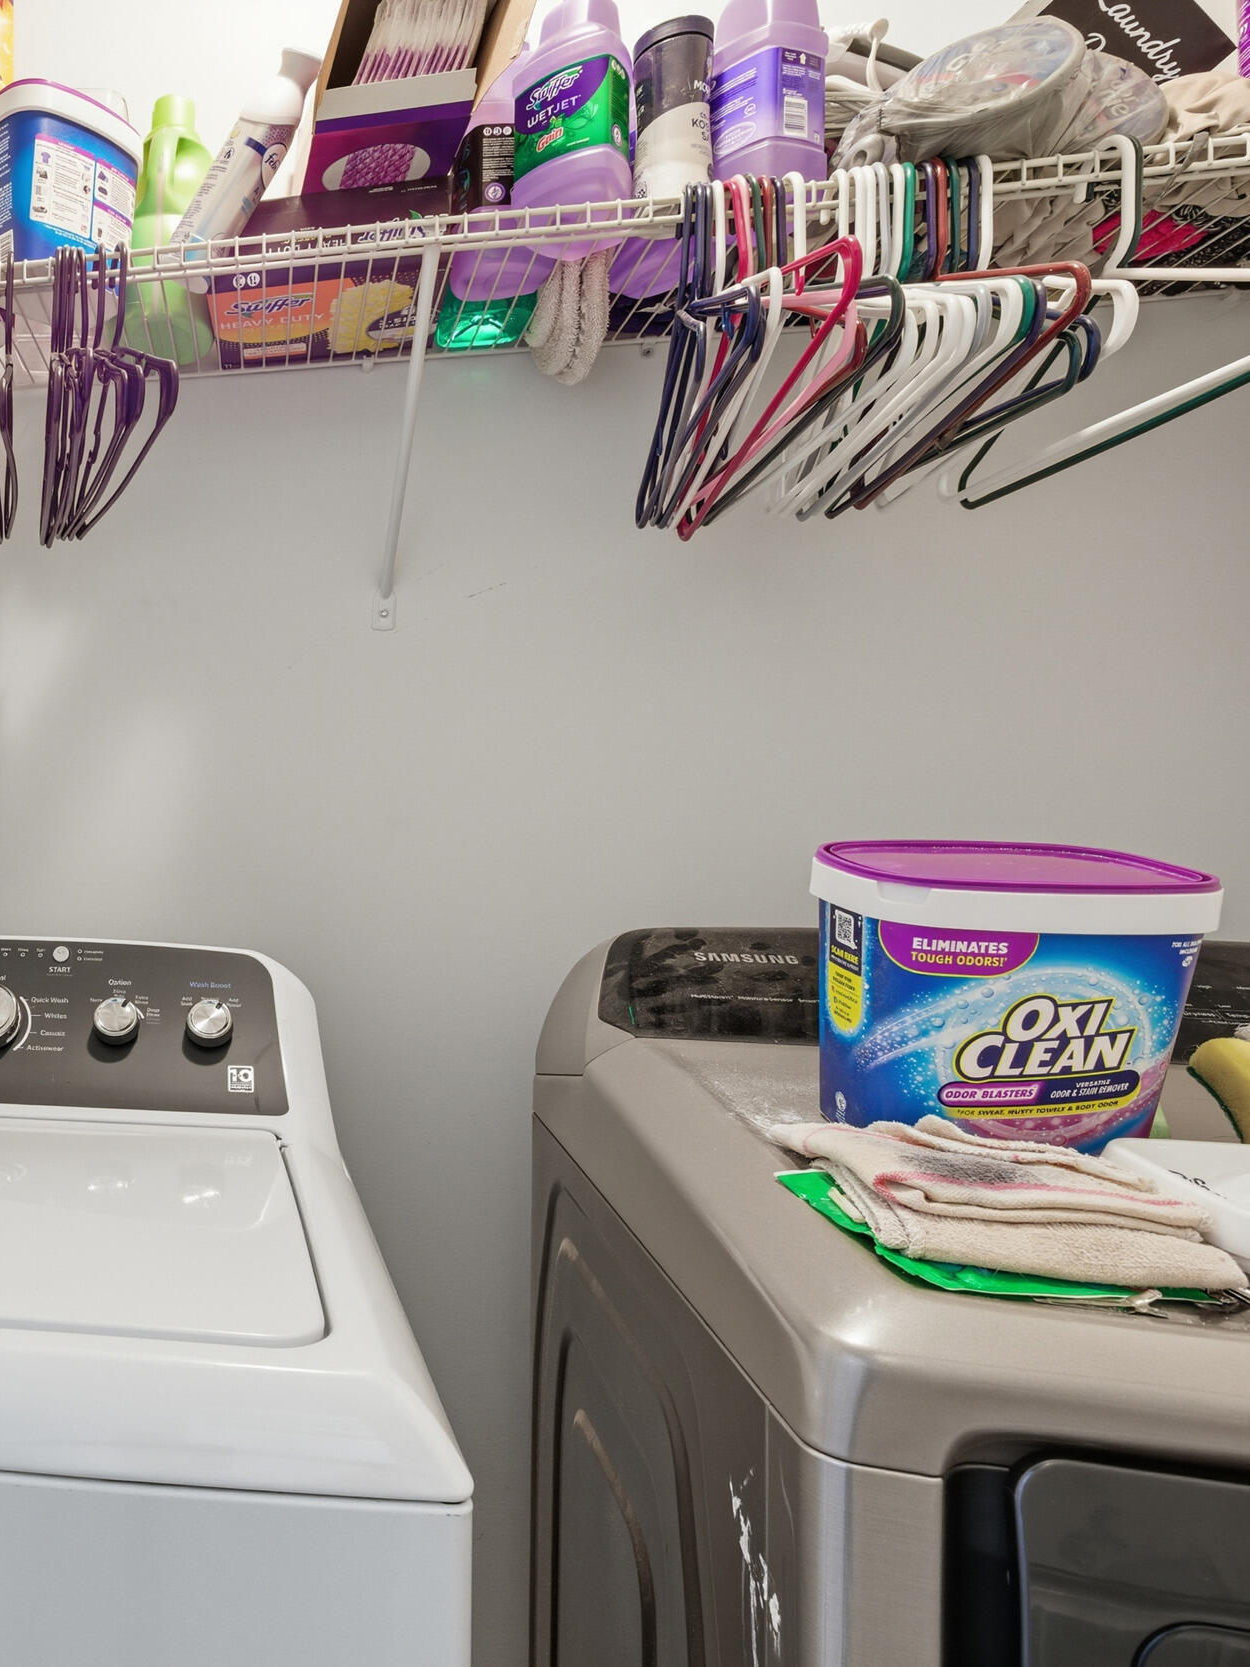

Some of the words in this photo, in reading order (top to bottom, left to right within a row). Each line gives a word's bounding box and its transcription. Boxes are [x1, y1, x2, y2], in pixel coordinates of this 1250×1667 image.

[527, 95, 579, 128] WETJET
[536, 126, 564, 153] Gain
[225, 296, 312, 317] Swiffer
[220, 315, 273, 331] HEAVY
[912, 937, 1009, 955] ELIMINATES
[693, 951, 799, 965] SAMSUNG
[910, 951, 953, 965] TOUGH
[108, 978, 132, 986] Option
[1006, 998, 1109, 1042] OXI
[959, 1032, 1131, 1079] CLEAN
[944, 1089, 977, 1100] ODOR
[981, 1087, 1035, 1100] BLASTERS
[1050, 1089, 1072, 1099] ODOR
[1071, 1088, 1078, 1097] &
[1097, 1100, 1120, 1108] ODOR
